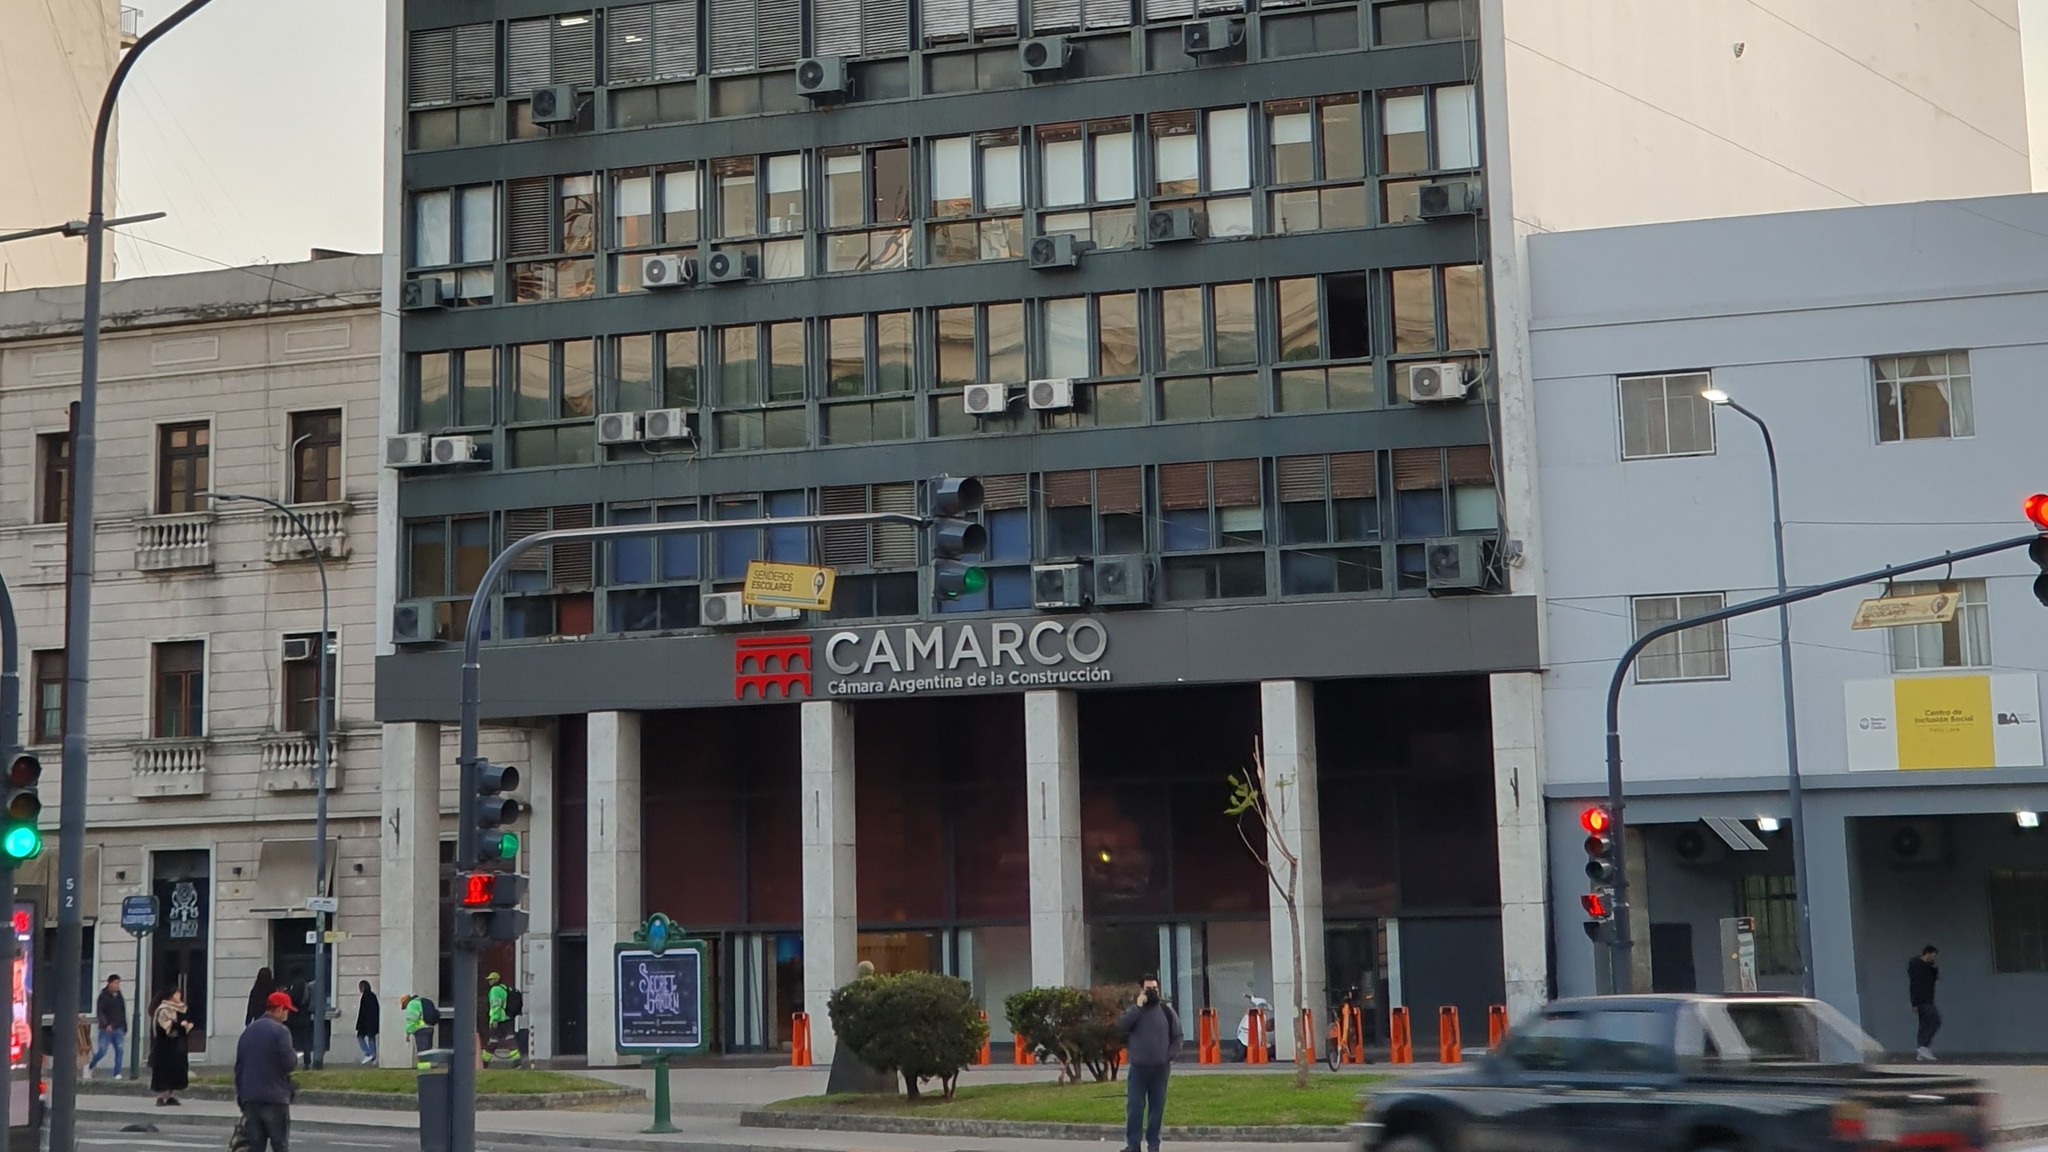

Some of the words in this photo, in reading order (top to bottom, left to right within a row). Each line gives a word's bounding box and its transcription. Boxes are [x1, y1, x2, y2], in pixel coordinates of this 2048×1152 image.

[753, 570, 794, 582] SENDEROS
[751, 581, 792, 592] ESCOLARES
[825, 617, 1107, 675] CAMARCO
[827, 678, 884, 694] Cámara
[887, 674, 963, 693] Argentina
[967, 671, 987, 686] de
[991, 671, 1005, 685] la
[1008, 667, 1111, 684] Construcción
